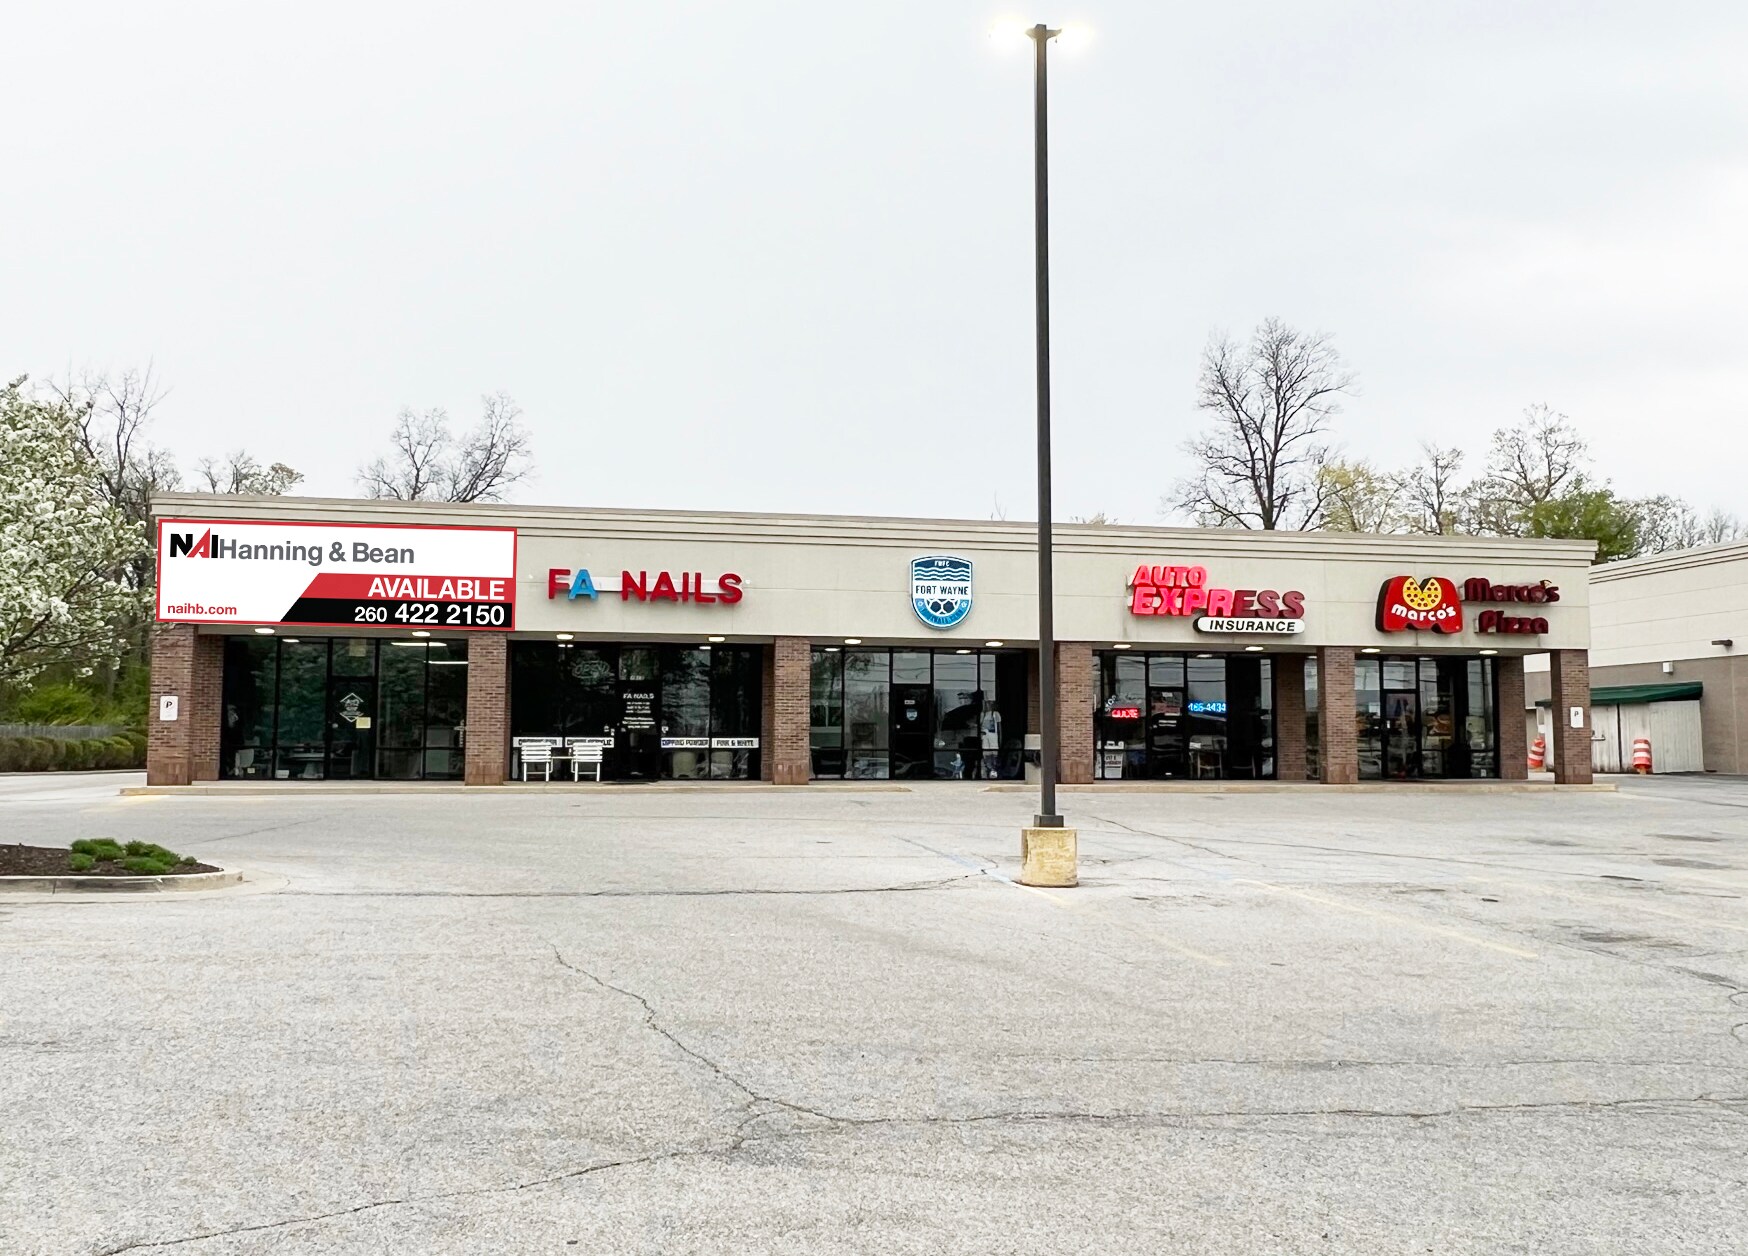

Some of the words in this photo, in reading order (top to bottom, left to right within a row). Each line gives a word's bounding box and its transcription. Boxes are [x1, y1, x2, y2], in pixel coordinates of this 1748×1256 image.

[170, 528, 218, 559] NAI
[219, 539, 323, 566] Hanning
[329, 542, 347, 562] &
[352, 542, 415, 564] Bean
[548, 568, 598, 601] FA
[621, 570, 744, 604] NAILS
[1132, 565, 1208, 588] AUTO
[367, 577, 505, 601] AVAILABLE
[915, 585, 937, 595] FORT
[939, 586, 969, 596] WAYNE
[167, 602, 238, 616] naihb.com
[1132, 586, 1305, 619] EXPRESS
[354, 606, 388, 623] 260
[394, 603, 439, 624] 422
[446, 604, 505, 626] 2150
[1209, 619, 1296, 632] INSURANCE
